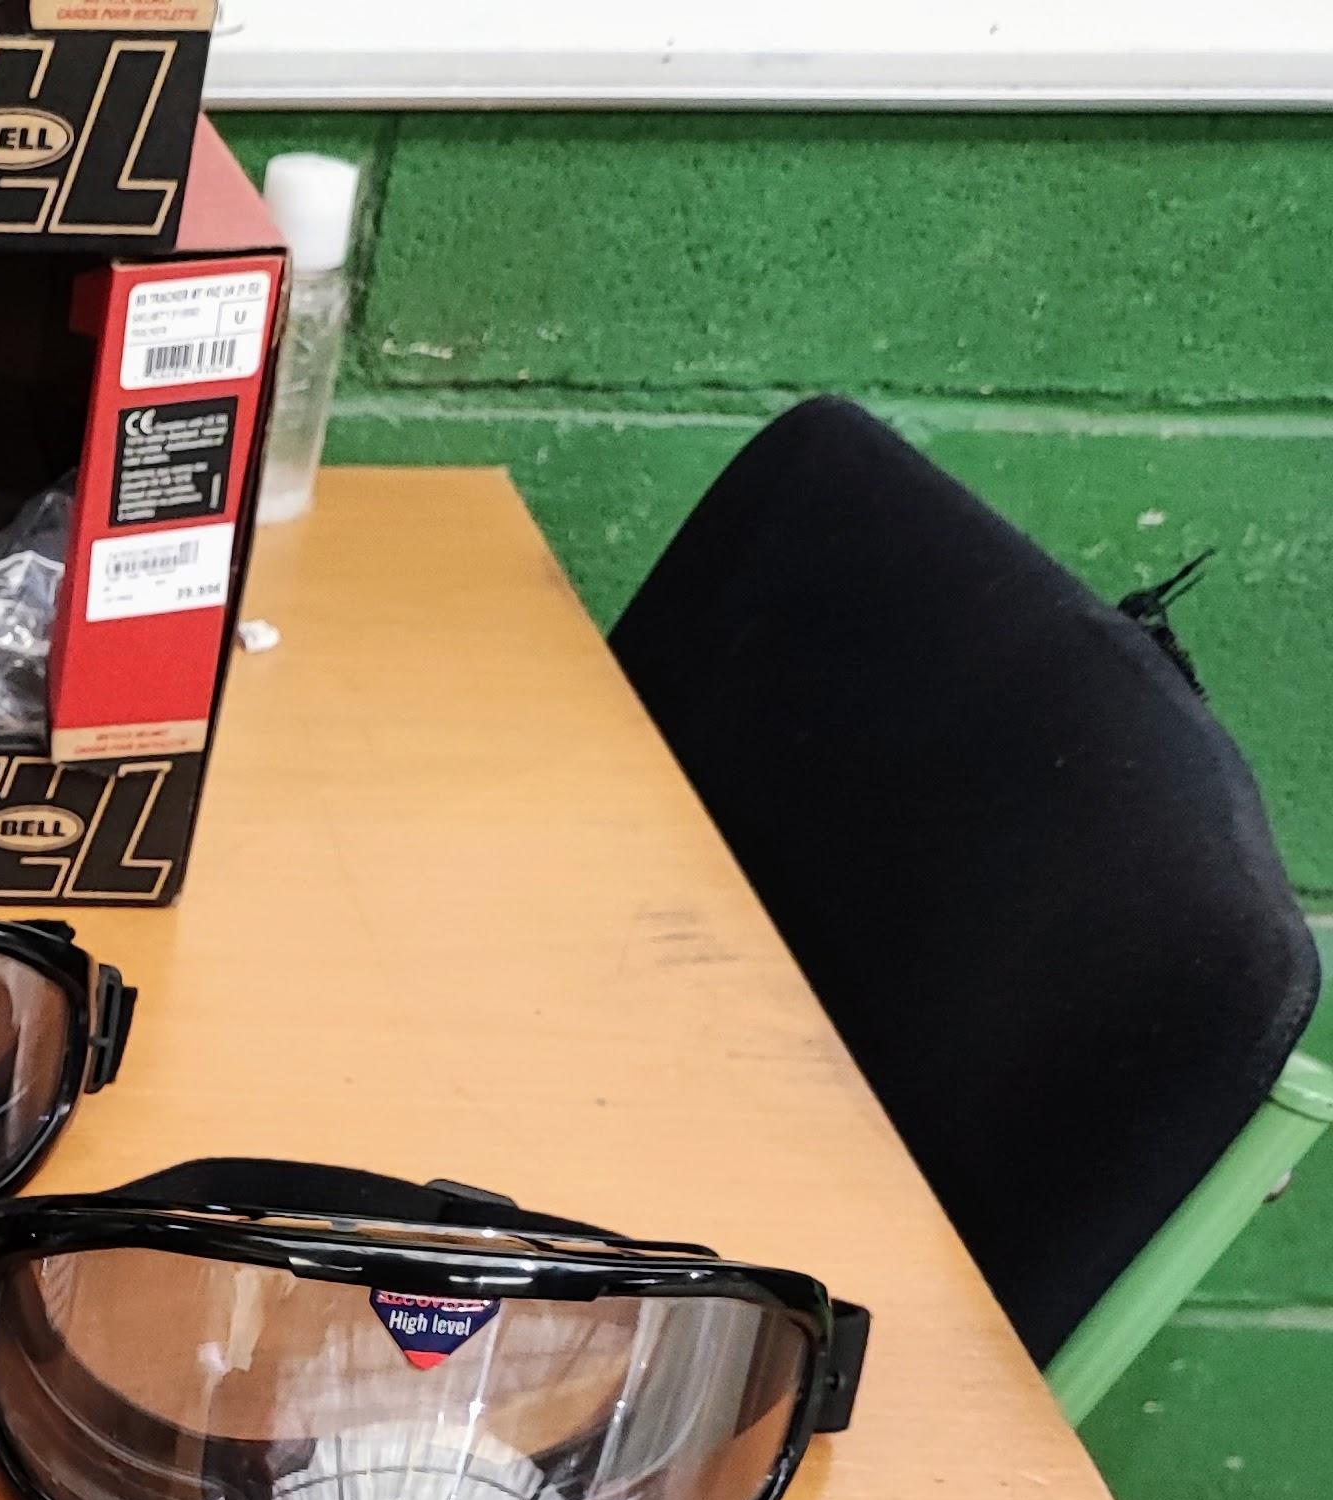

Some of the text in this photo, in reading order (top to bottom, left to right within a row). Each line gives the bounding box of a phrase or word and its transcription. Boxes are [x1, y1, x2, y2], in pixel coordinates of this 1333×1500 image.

[0, 819, 67, 837] BELL
[389, 1310, 471, 1336] High level
